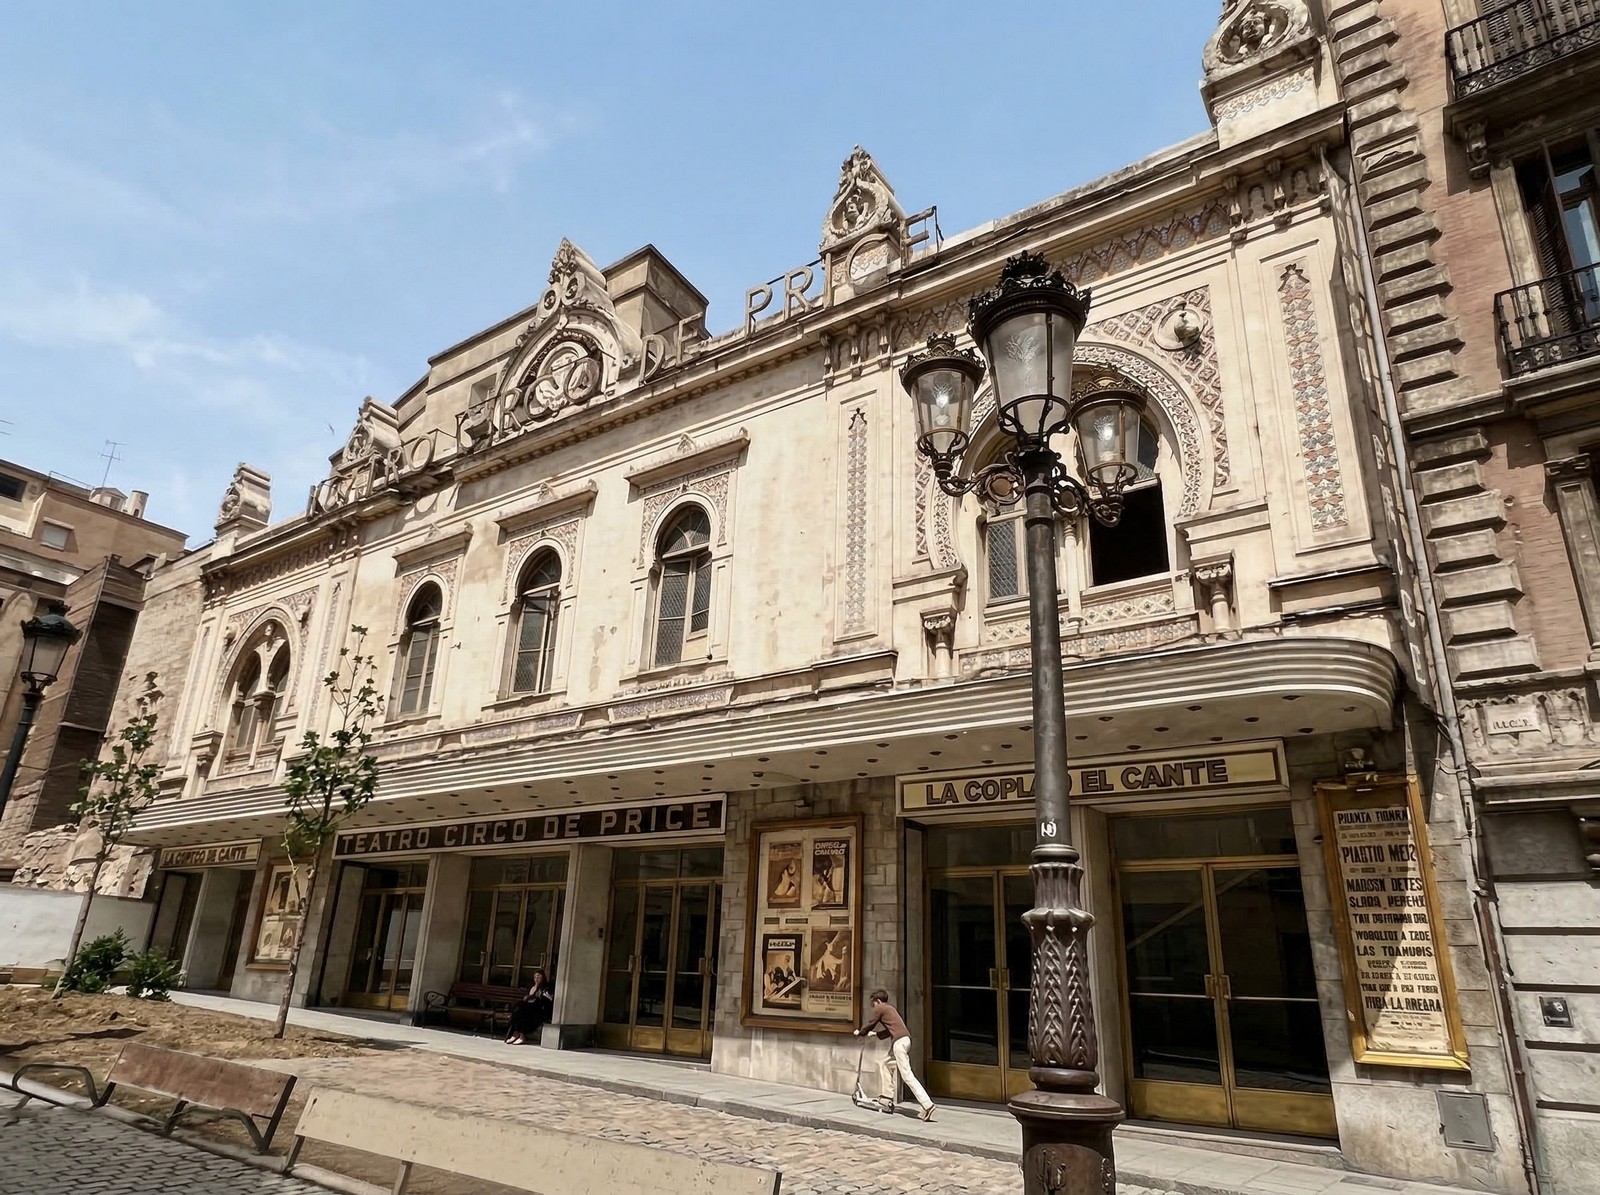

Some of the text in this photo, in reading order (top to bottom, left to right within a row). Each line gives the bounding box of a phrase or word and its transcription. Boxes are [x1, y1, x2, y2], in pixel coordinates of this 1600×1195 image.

[638, 311, 703, 386] DE
[745, 205, 937, 335] PRICE
[925, 783, 957, 805] LA
[1081, 769, 1114, 794] EL
[1120, 759, 1229, 790] CANTE
[342, 802, 712, 854] TEATRO CIRCO DE PRICE
[1356, 945, 1376, 957] LAS
